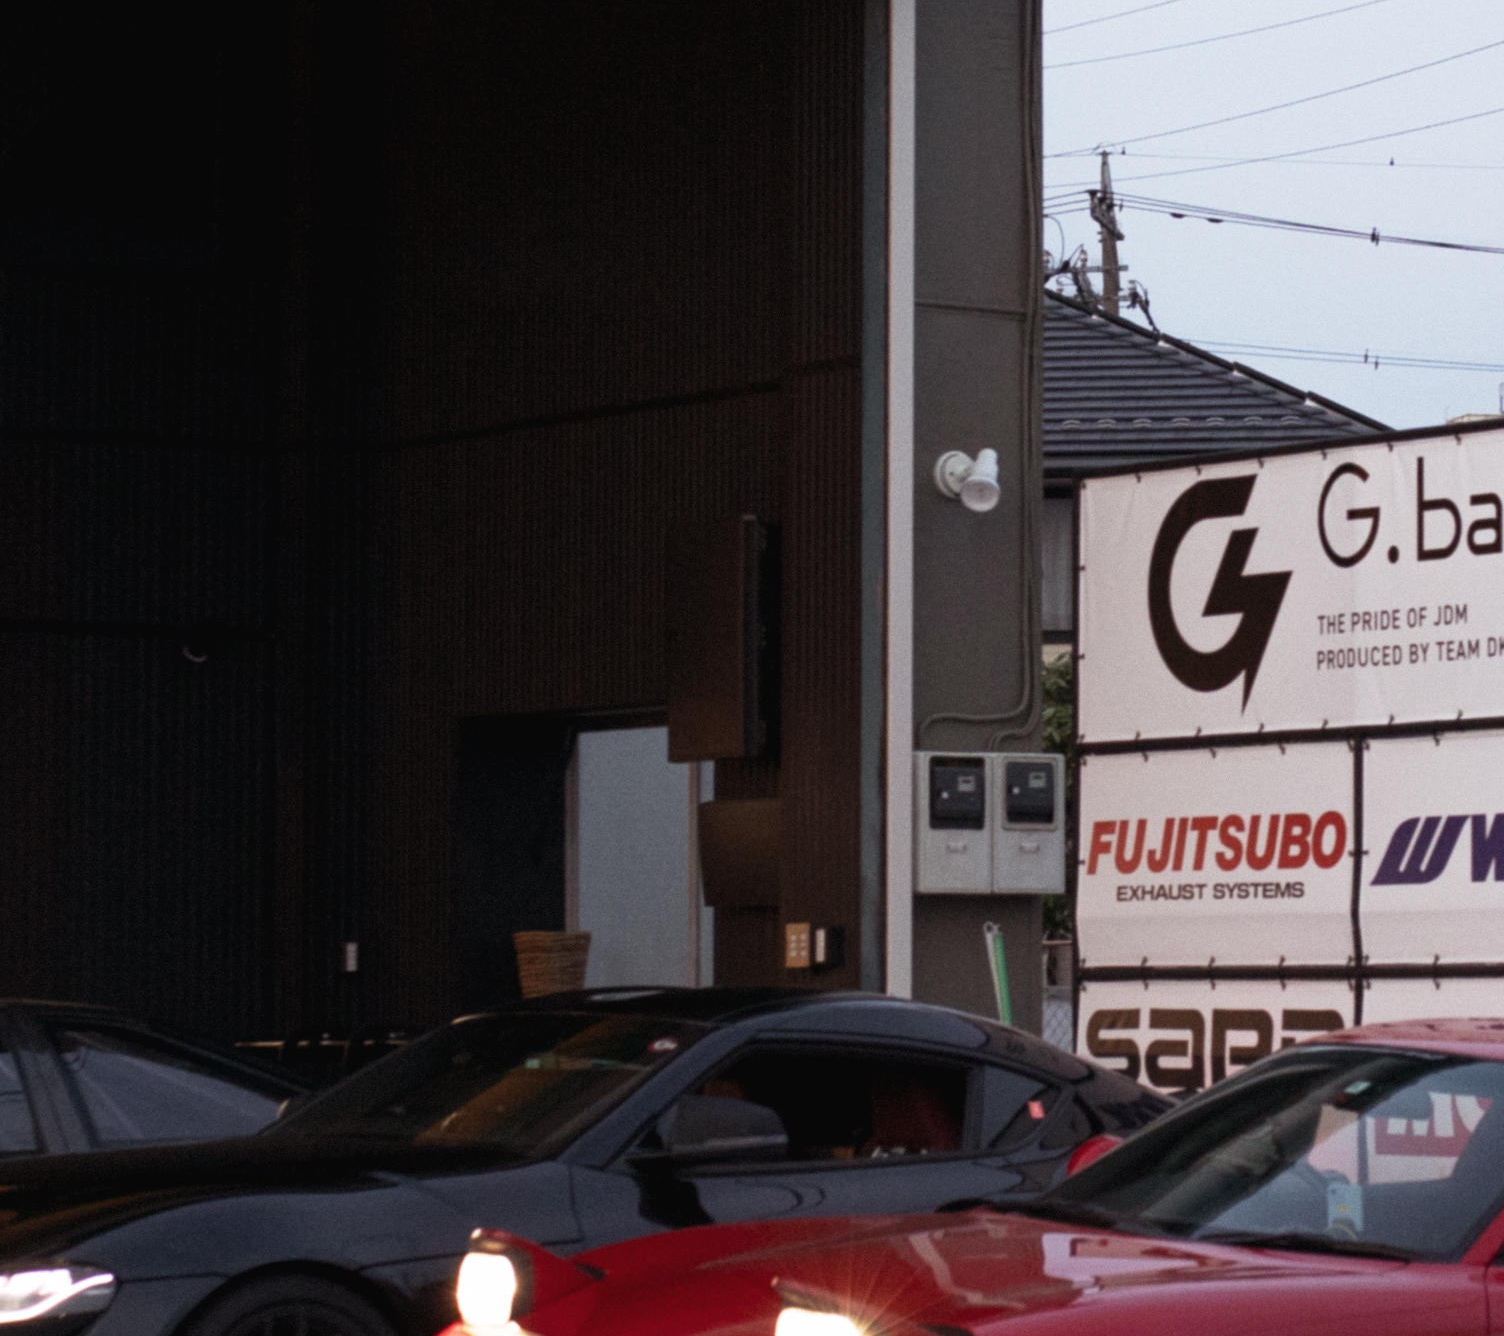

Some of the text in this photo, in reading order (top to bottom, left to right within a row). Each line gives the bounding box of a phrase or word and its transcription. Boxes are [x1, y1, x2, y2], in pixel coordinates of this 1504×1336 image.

[1317, 603, 1468, 635] THE PRIDE OF JDM
[1316, 644, 1402, 670] PRODUCED
[1409, 642, 1430, 664] BY
[1435, 638, 1480, 662] TEAM
[1086, 810, 1349, 876] FUJITSUBO
[1116, 881, 1305, 902] EXHAUST SYSTEMS
